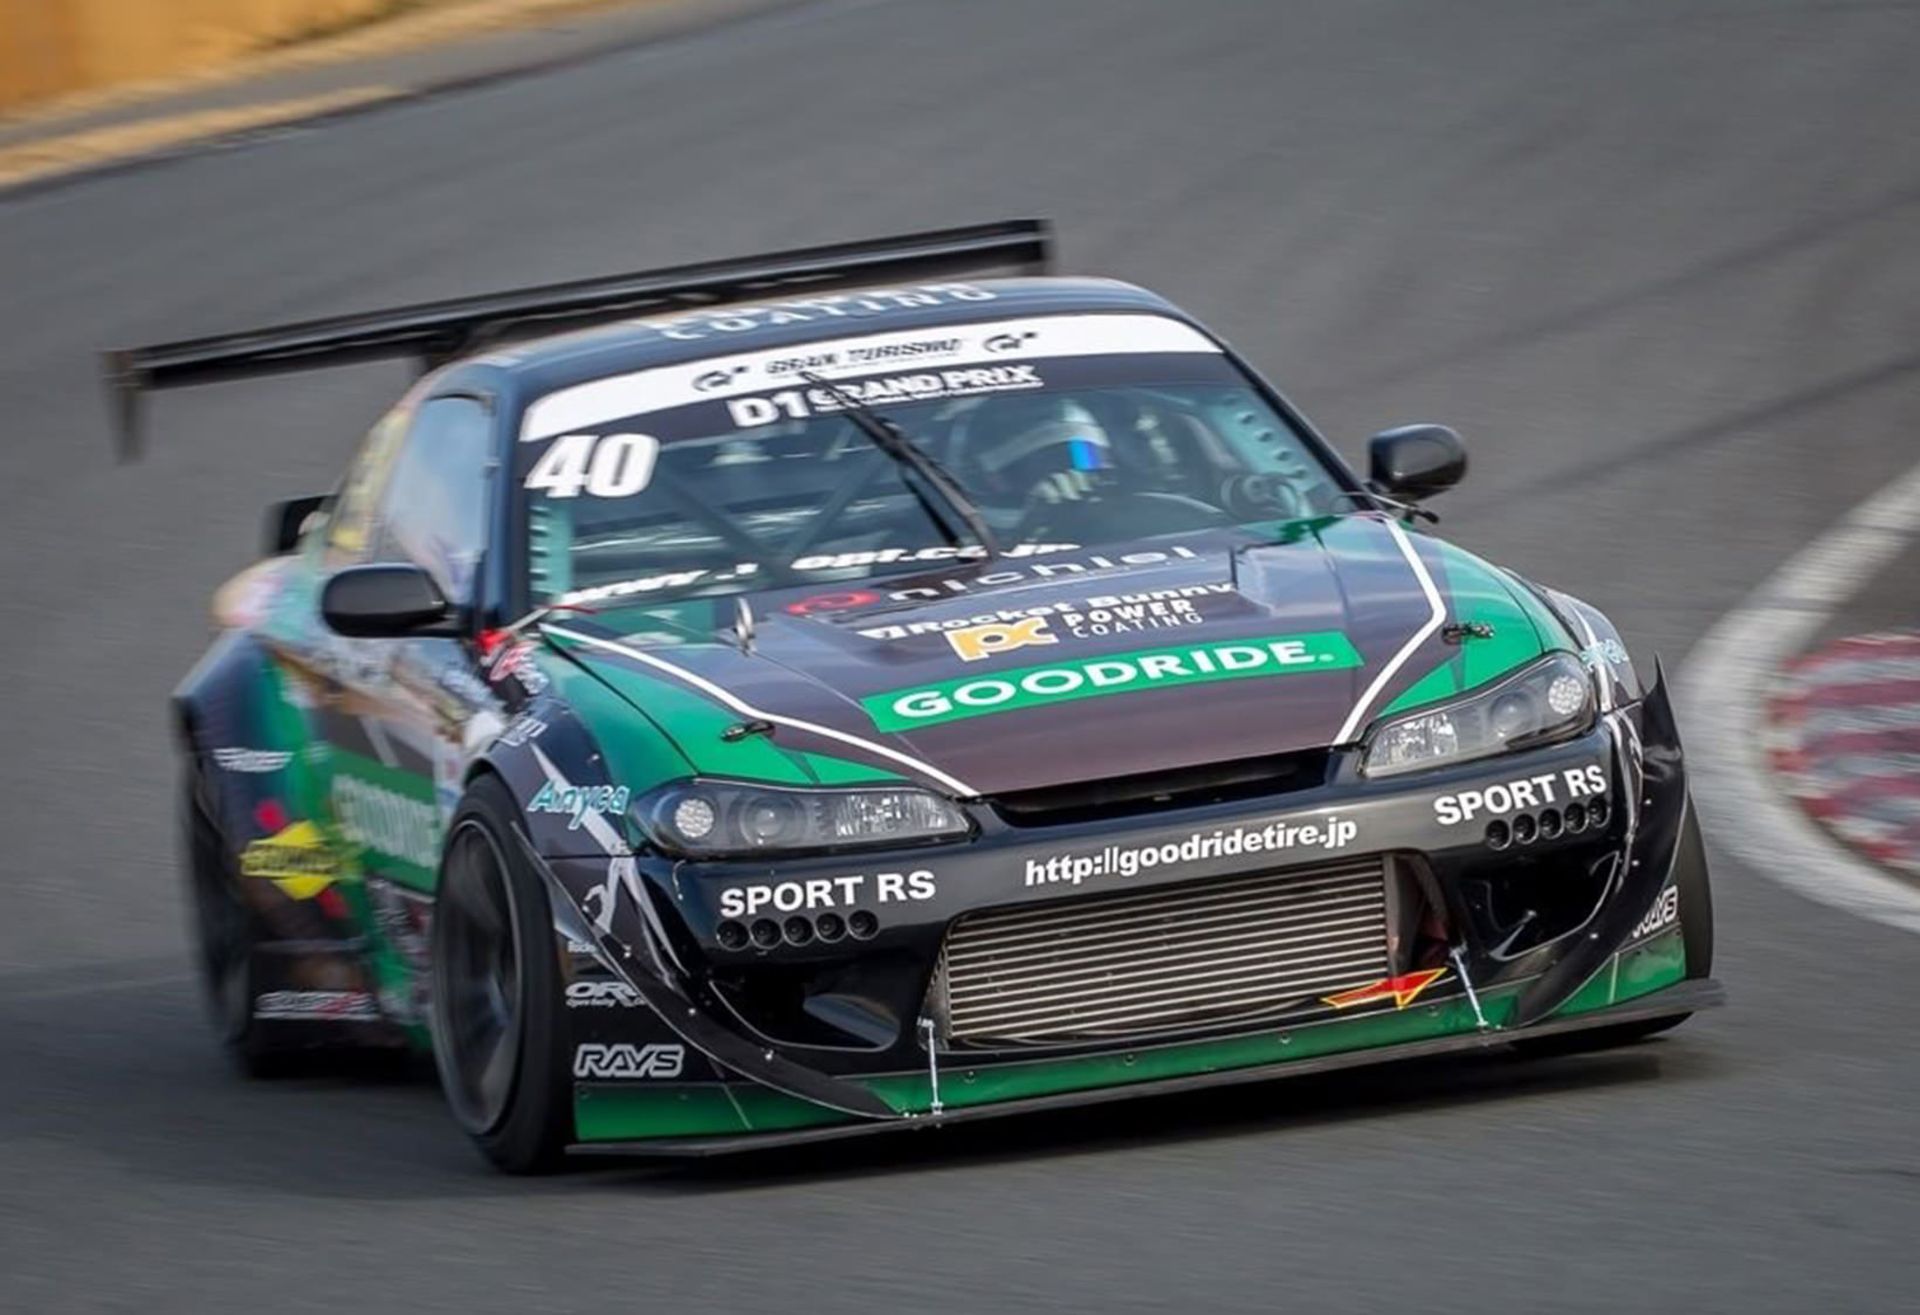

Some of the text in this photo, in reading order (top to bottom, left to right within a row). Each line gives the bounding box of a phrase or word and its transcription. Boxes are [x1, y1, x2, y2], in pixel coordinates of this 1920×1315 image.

[728, 390, 813, 428] D1
[941, 365, 1045, 392] PRIX
[524, 434, 661, 498] 40
[1062, 599, 1197, 627] POWER
[1072, 616, 1203, 638] COATING
[1433, 764, 1608, 825] SPORT RS
[1024, 816, 1358, 886] http://goodridetire.jp
[719, 870, 936, 918] SPORT RS
[573, 1043, 684, 1078] RAYS
